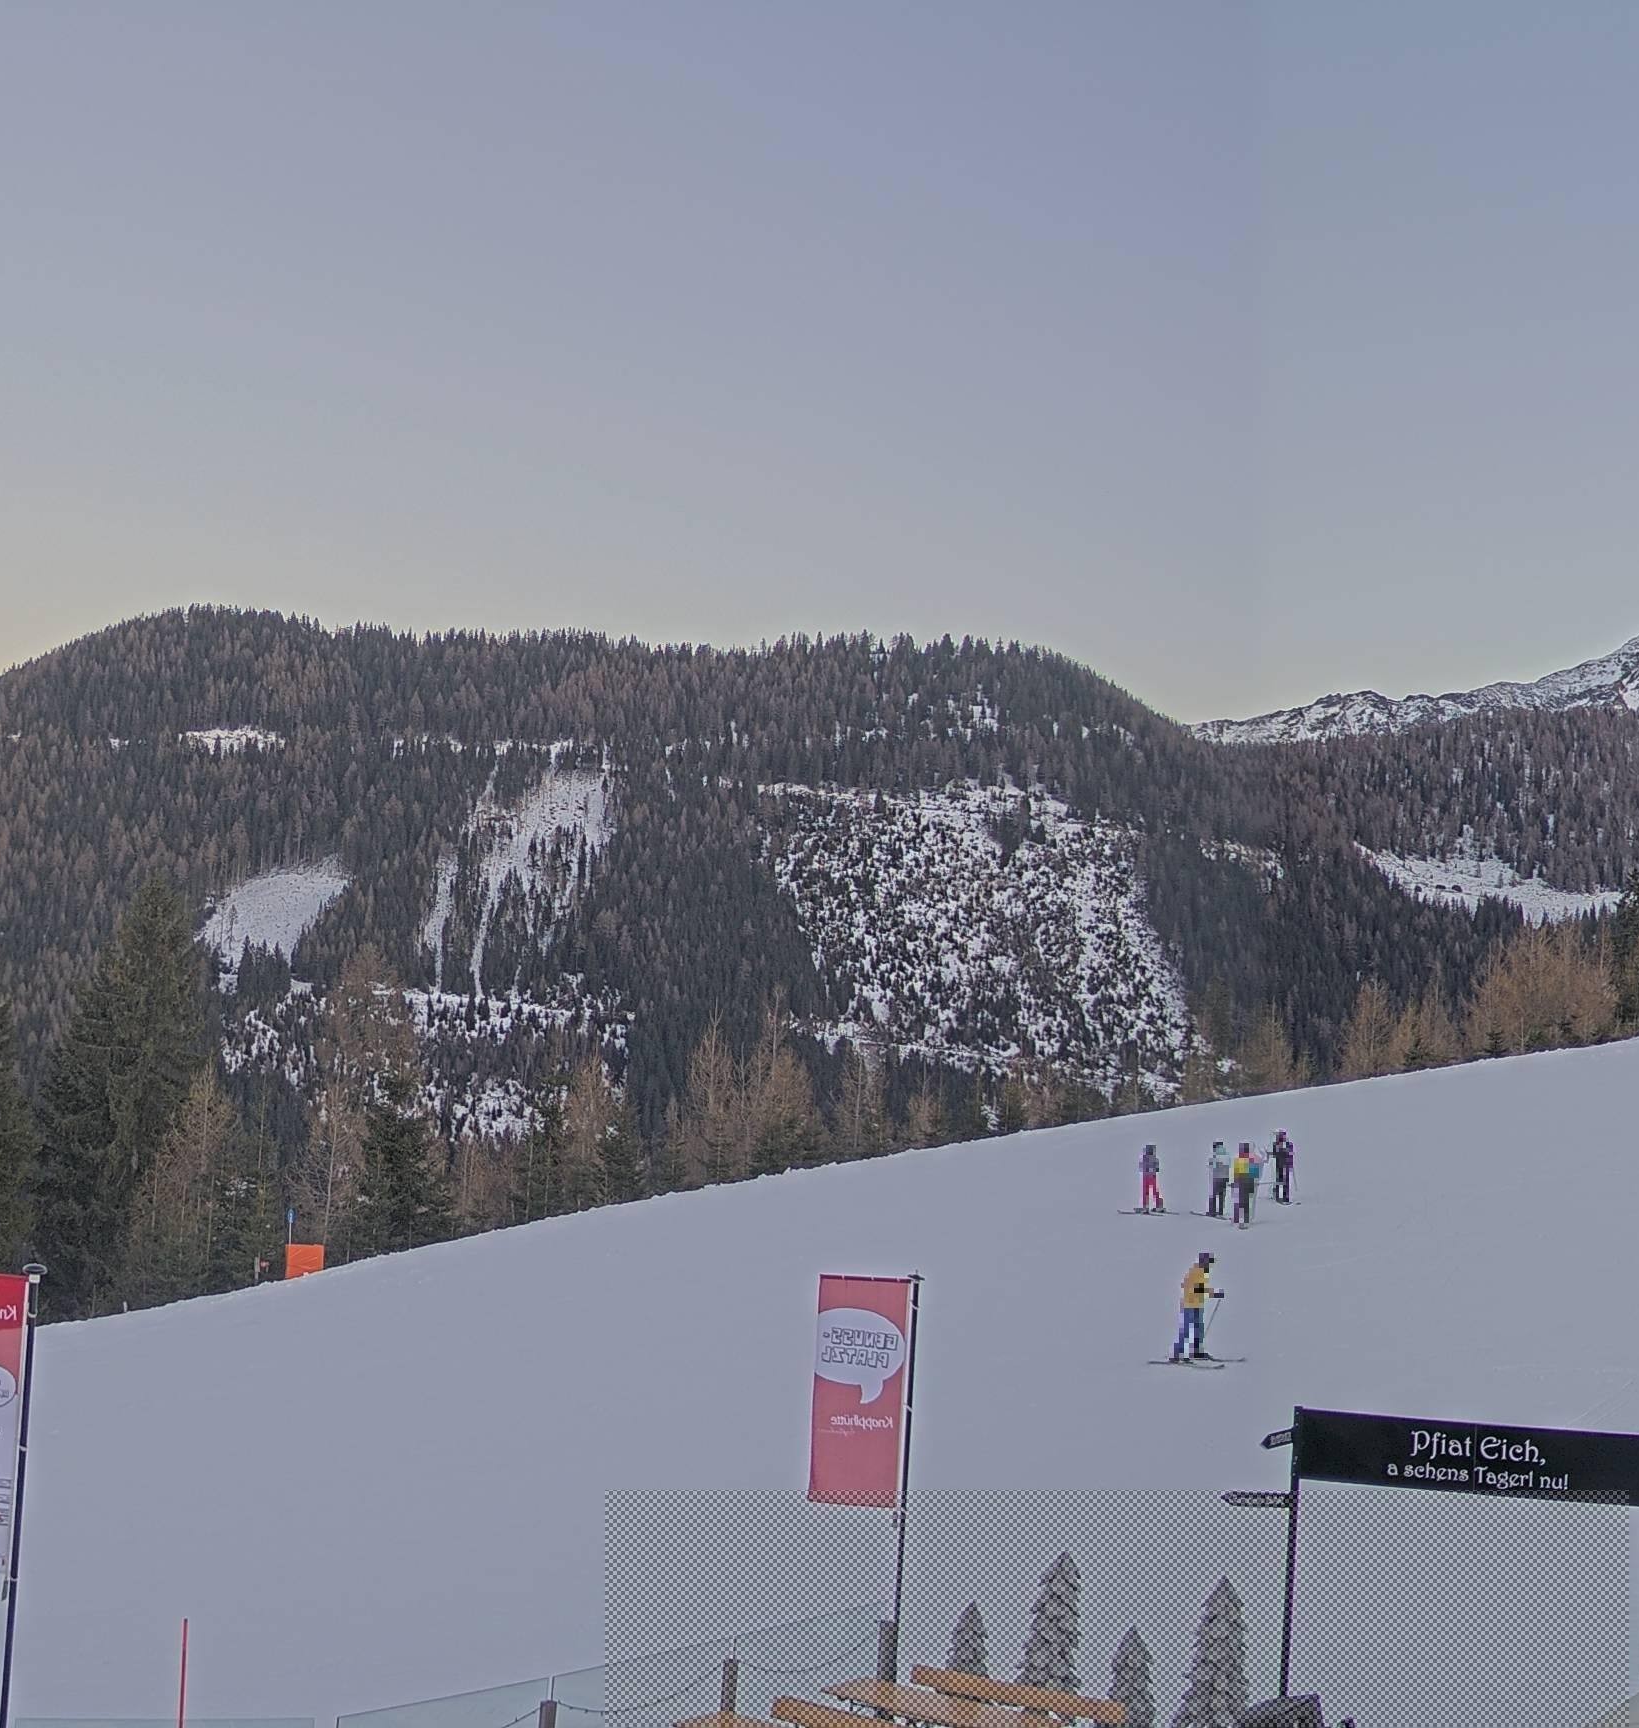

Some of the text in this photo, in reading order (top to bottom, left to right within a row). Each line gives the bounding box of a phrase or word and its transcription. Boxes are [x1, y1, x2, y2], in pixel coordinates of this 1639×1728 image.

[1409, 1429, 1547, 1466] Pfiat Eich,
[1387, 1462, 1570, 1491] a schens Tagerl nu!
